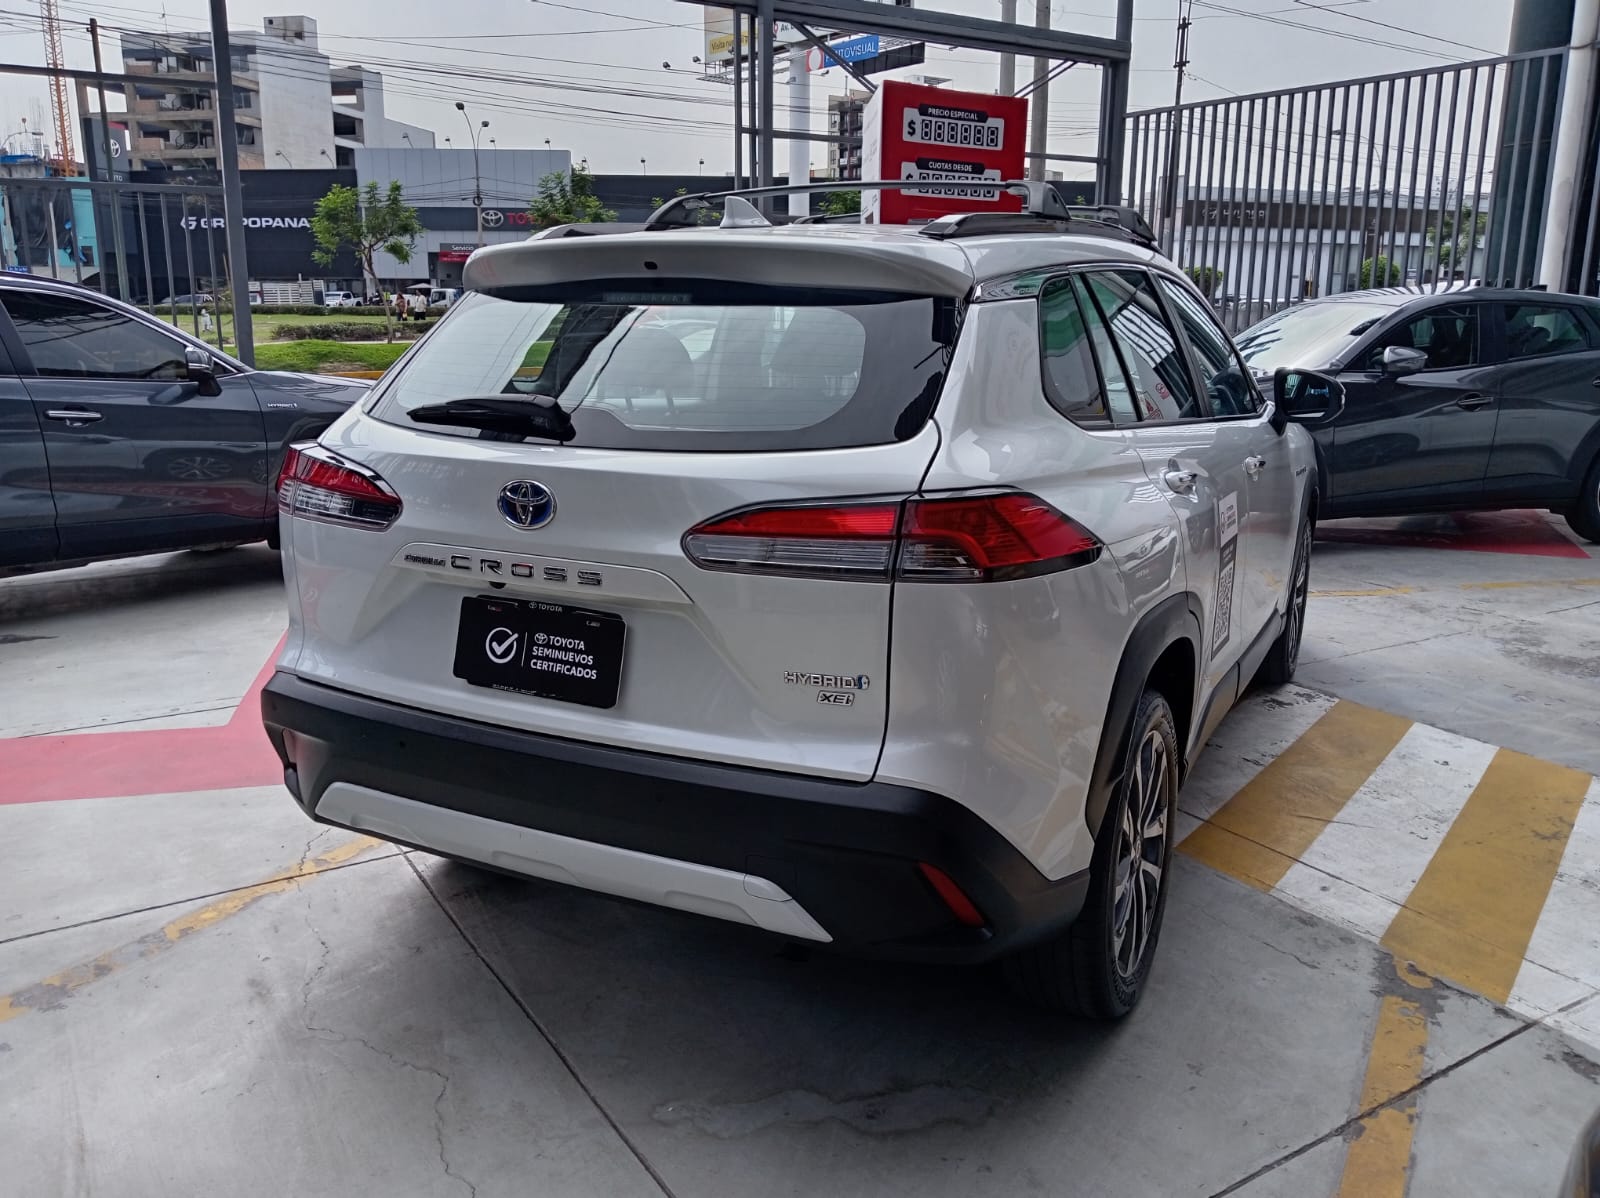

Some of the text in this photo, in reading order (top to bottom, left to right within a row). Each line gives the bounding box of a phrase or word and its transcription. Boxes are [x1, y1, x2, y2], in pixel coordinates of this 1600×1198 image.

[928, 107, 978, 120] PRECIO ESPECIAL
[928, 161, 972, 172] CUOTAS DESDE
[450, 554, 603, 586] CROSS
[538, 603, 563, 613] TOYOTA
[549, 635, 585, 650] TOYOTA
[532, 646, 594, 665] SEMINUEVOS
[530, 659, 597, 680] CERTIFICADOS
[784, 671, 855, 689] HYBRID
